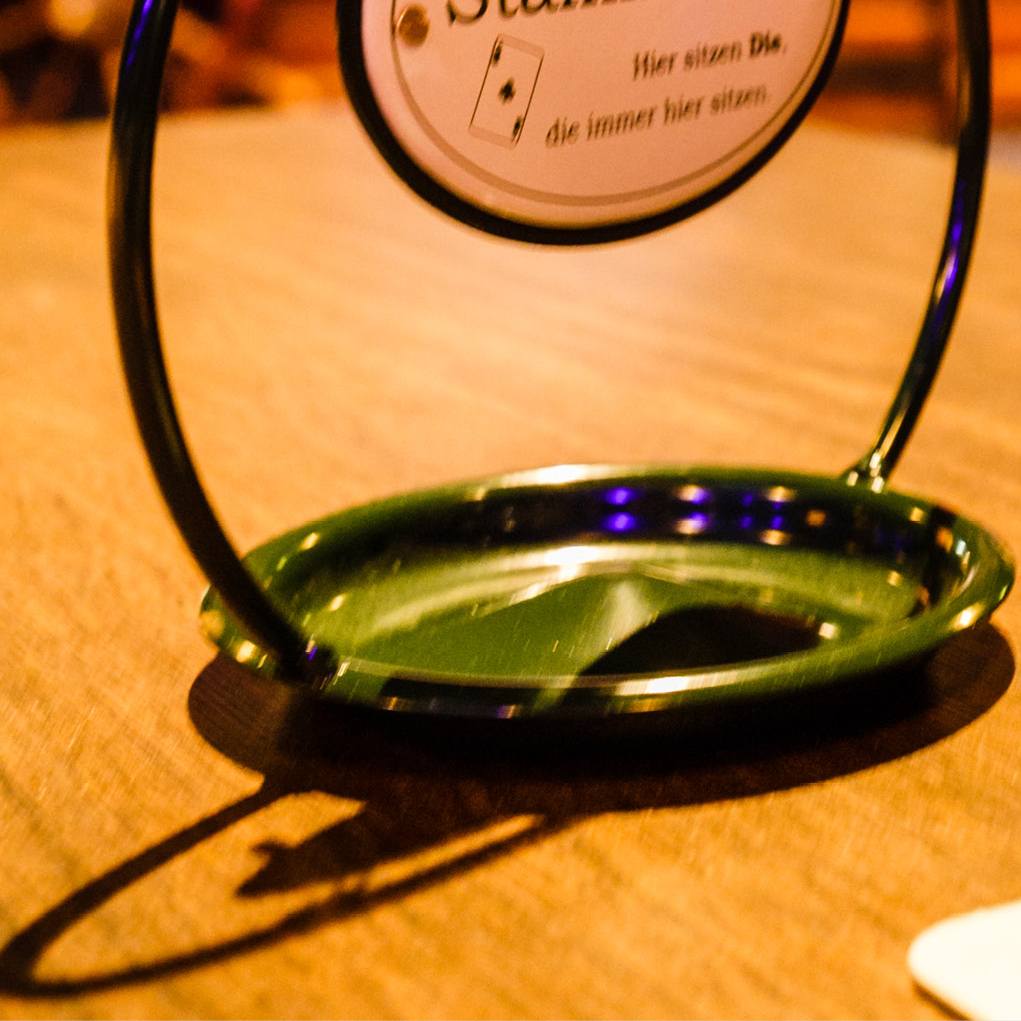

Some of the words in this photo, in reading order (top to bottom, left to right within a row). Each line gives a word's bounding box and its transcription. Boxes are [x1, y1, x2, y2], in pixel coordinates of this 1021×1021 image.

[632, 50, 678, 81] Hier
[683, 40, 742, 71] sitzen
[545, 116, 580, 148] die
[587, 111, 657, 140] immer
[663, 92, 705, 125] hier
